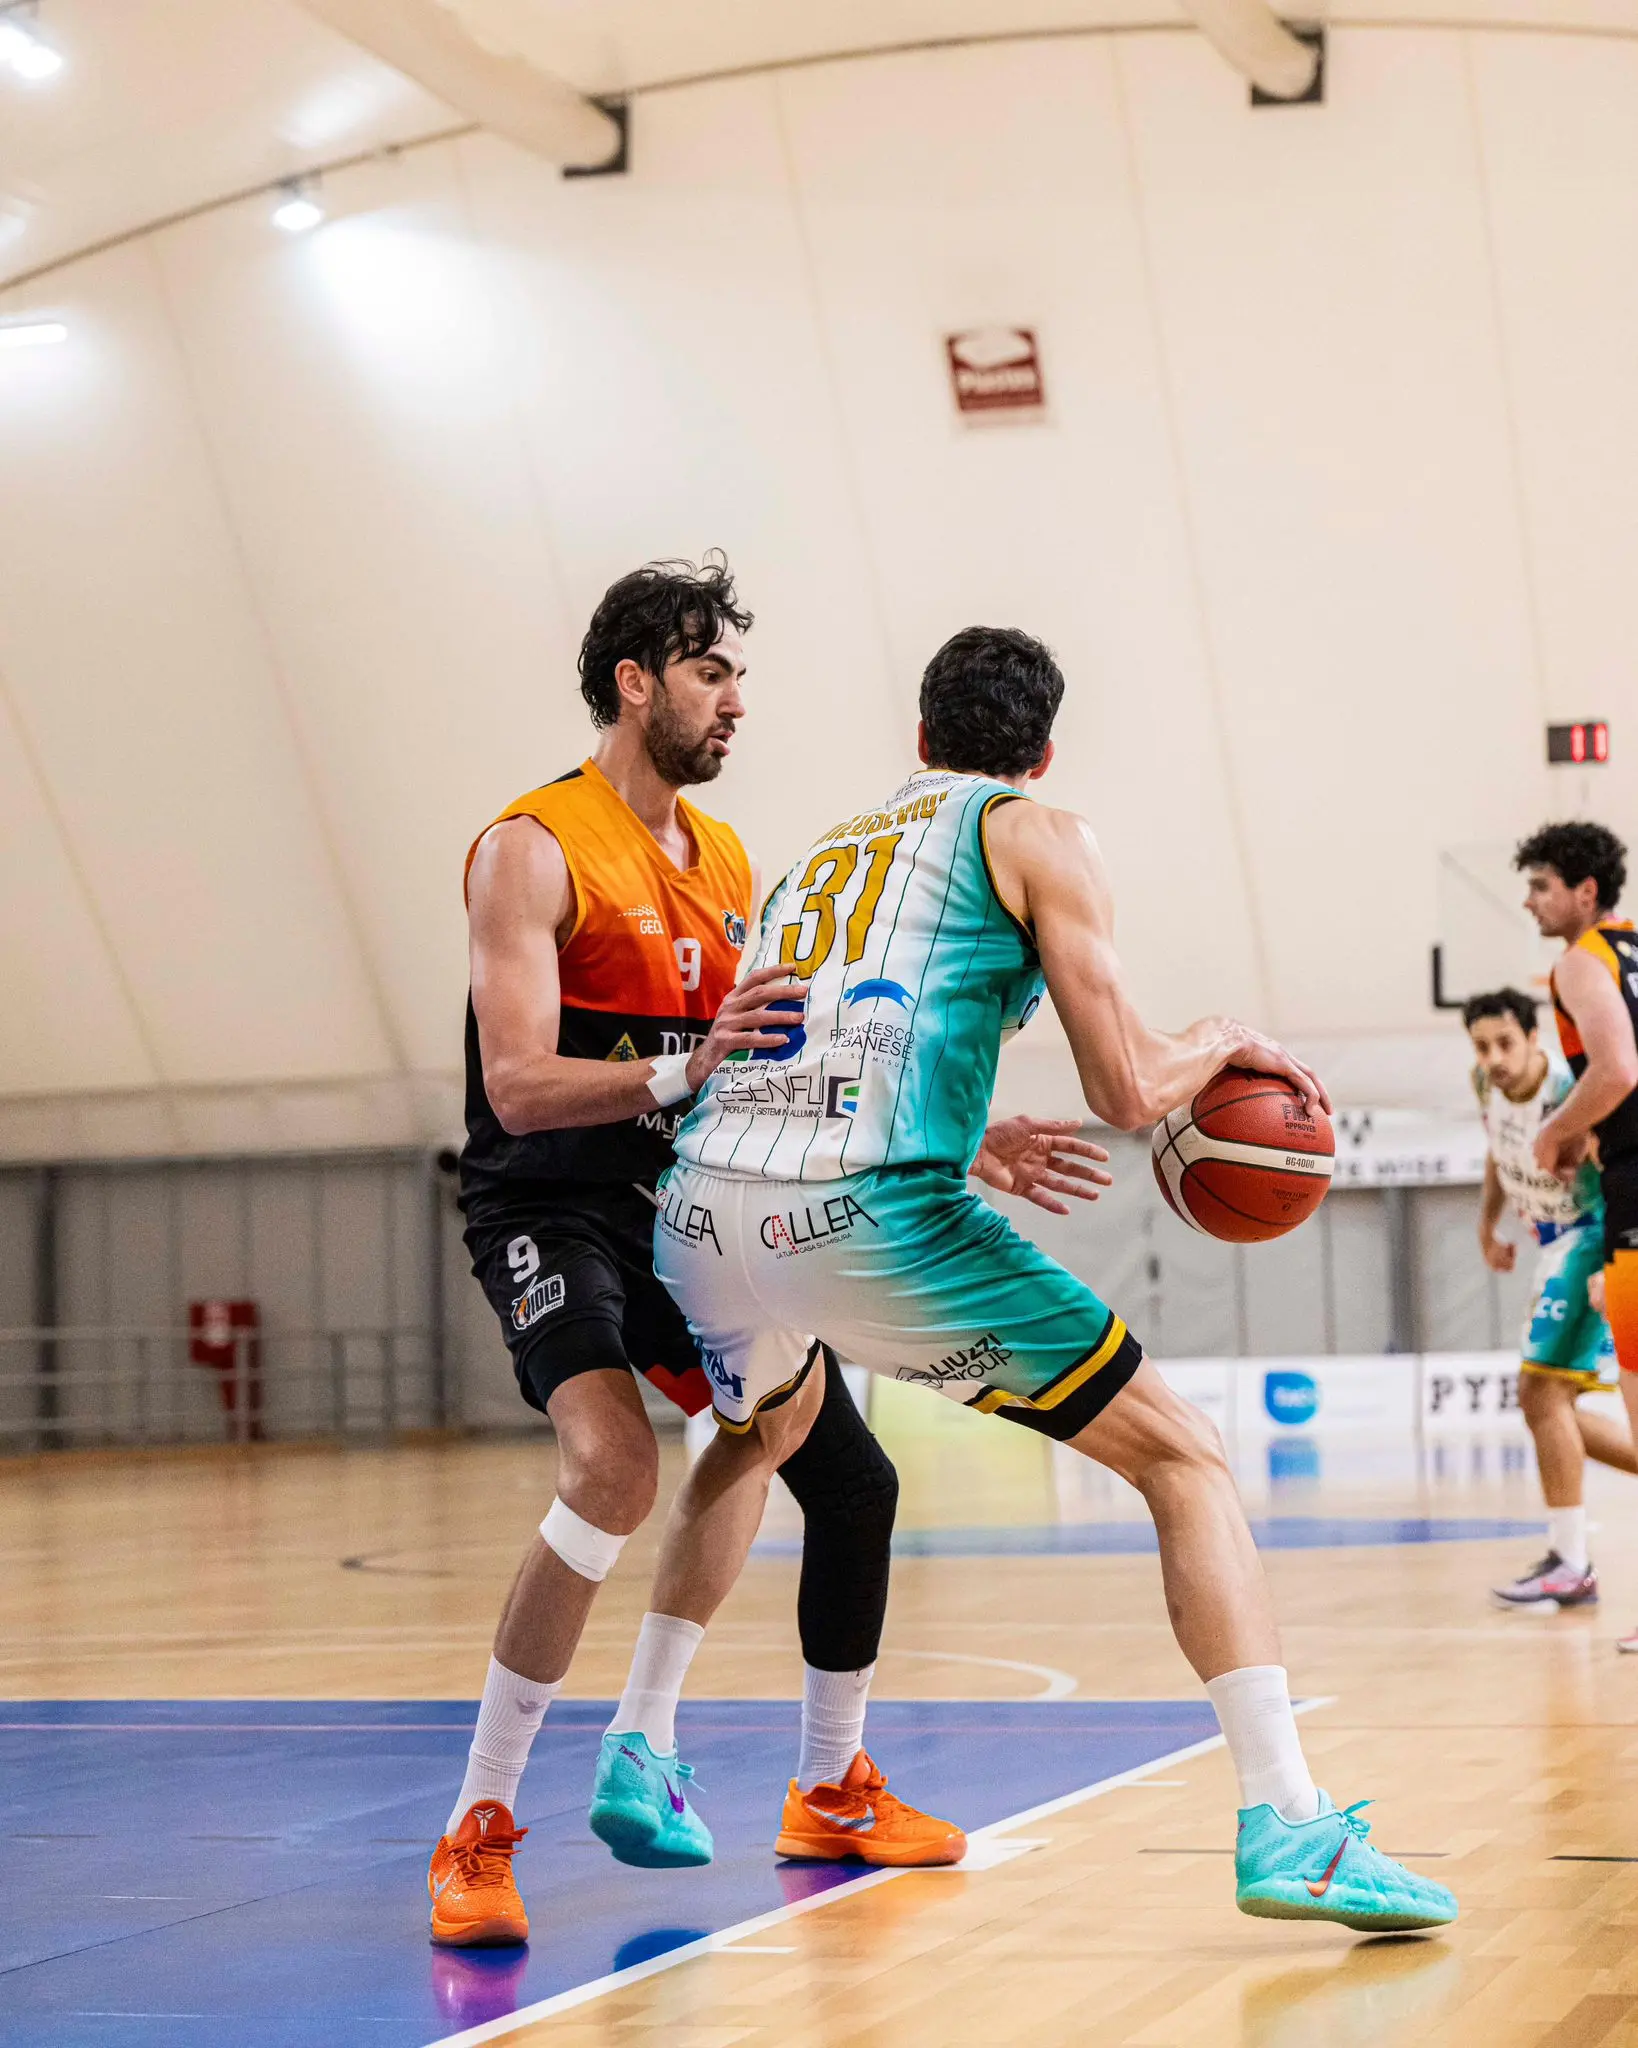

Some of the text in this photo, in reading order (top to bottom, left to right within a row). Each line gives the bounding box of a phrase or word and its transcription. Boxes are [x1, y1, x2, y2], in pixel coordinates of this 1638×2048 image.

[779, 832, 904, 980] 31
[672, 937, 702, 992] 9
[830, 1021, 916, 1045] FRANCESCO
[832, 1034, 913, 1061] LBANESE
[1285, 1121, 1317, 1133] APPROVED
[1284, 1155, 1316, 1169] BG4000
[760, 1194, 880, 1255] CALLEA
[799, 1244, 816, 1254] CASA
[816, 1241, 826, 1250] SU
[826, 1232, 853, 1246] MISURA
[507, 1235, 540, 1283] 9
[929, 1332, 1003, 1377] LIUZZI
[618, 1744, 646, 1772] TWELVE
